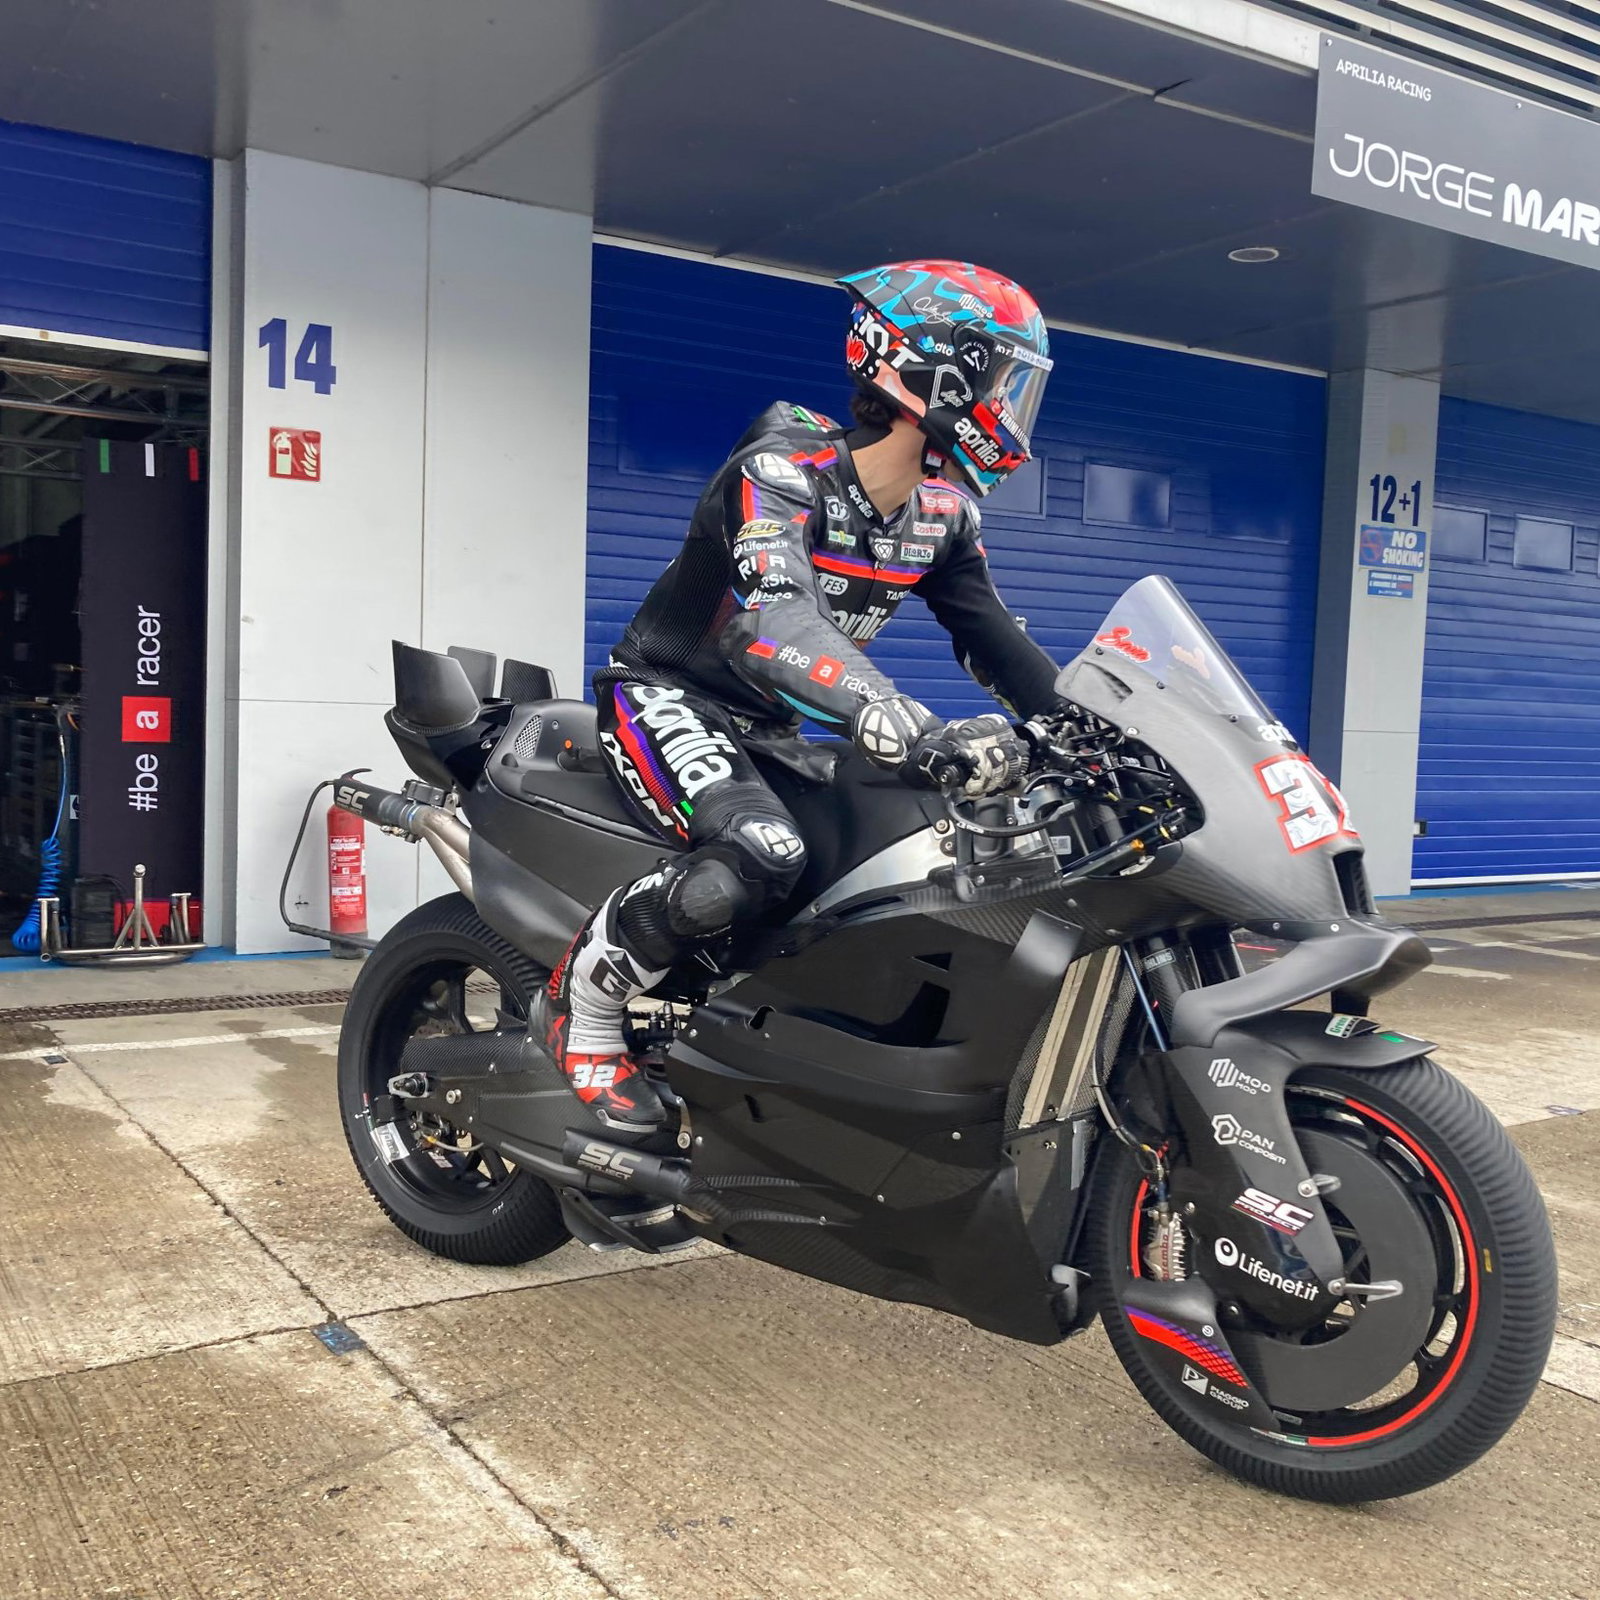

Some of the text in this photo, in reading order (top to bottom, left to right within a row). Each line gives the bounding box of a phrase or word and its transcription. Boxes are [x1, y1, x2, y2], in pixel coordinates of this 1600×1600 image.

[1336, 59, 1432, 101] APRILIA RACING
[1329, 133, 1495, 217] JORGE
[259, 317, 337, 395] 14
[935, 341, 953, 356] dto
[954, 417, 1000, 467] aprilia
[848, 484, 874, 519] aprilia
[924, 496, 954, 509] BS
[1370, 474, 1421, 527] 12+1
[915, 524, 944, 535] Castrol
[1391, 531, 1418, 549] NO
[1382, 547, 1424, 568] SMOKING
[778, 645, 811, 669] #be
[819, 665, 833, 678] a
[128, 604, 161, 812] #be a racer
[631, 686, 738, 800] aprilia
[336, 785, 370, 810] SC
[573, 1063, 617, 1089] 32
[1241, 1130, 1275, 1150] PAN
[579, 1142, 642, 1175] SC
[1234, 1200, 1301, 1231] PROJECT
[1238, 1187, 1314, 1228] SC
[1161, 1234, 1169, 1281] brembo
[1239, 1252, 1319, 1301] Lifenet.it
[1209, 1390, 1244, 1411] GROUP
[1210, 1385, 1250, 1408] PIAGGIO
